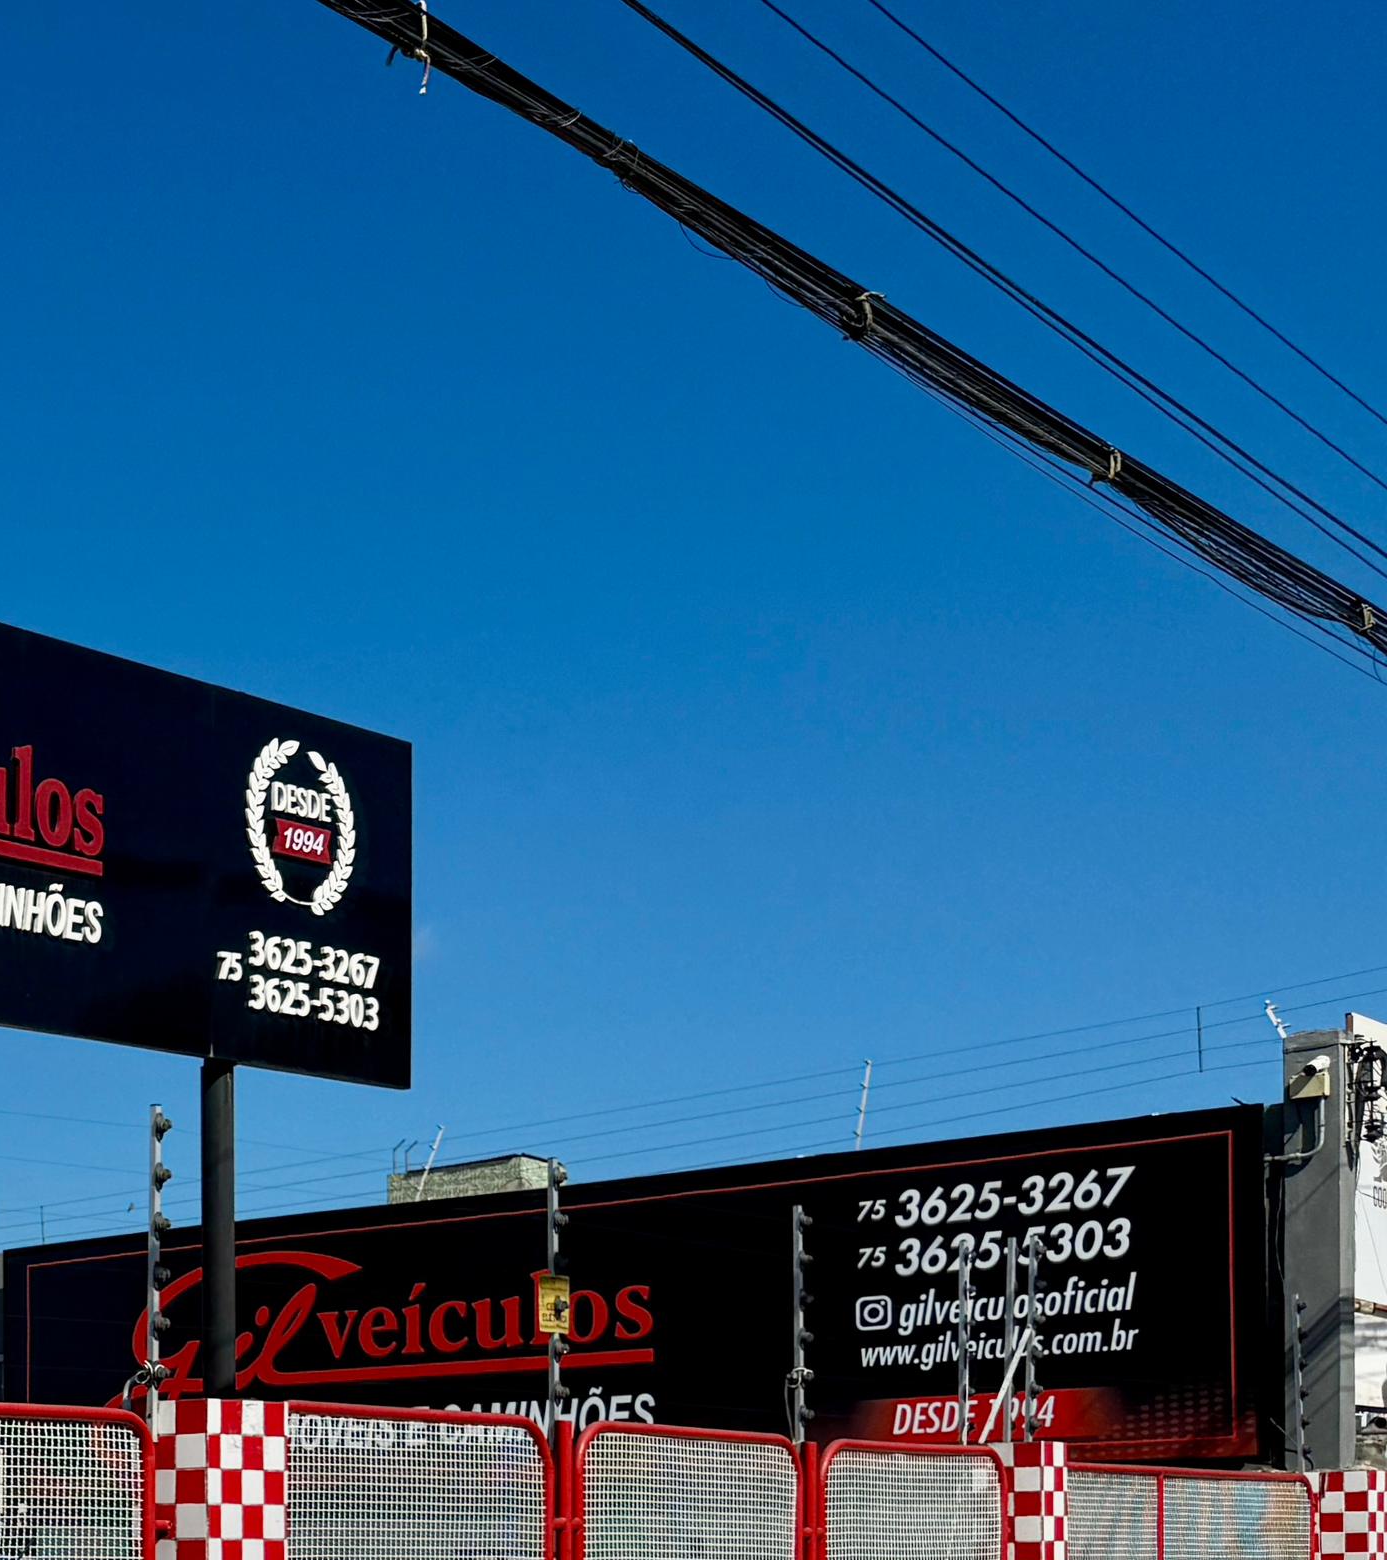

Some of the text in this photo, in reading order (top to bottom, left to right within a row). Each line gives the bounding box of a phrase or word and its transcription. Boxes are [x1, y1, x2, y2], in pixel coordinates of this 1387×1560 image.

[270, 781, 333, 823] DESDE
[283, 826, 325, 856] 1994
[215, 930, 381, 990] 75 3625-3267
[247, 974, 380, 1032] 3625-5303
[856, 1165, 1137, 1228] 75 3625-3267
[856, 1246, 887, 1270] 75
